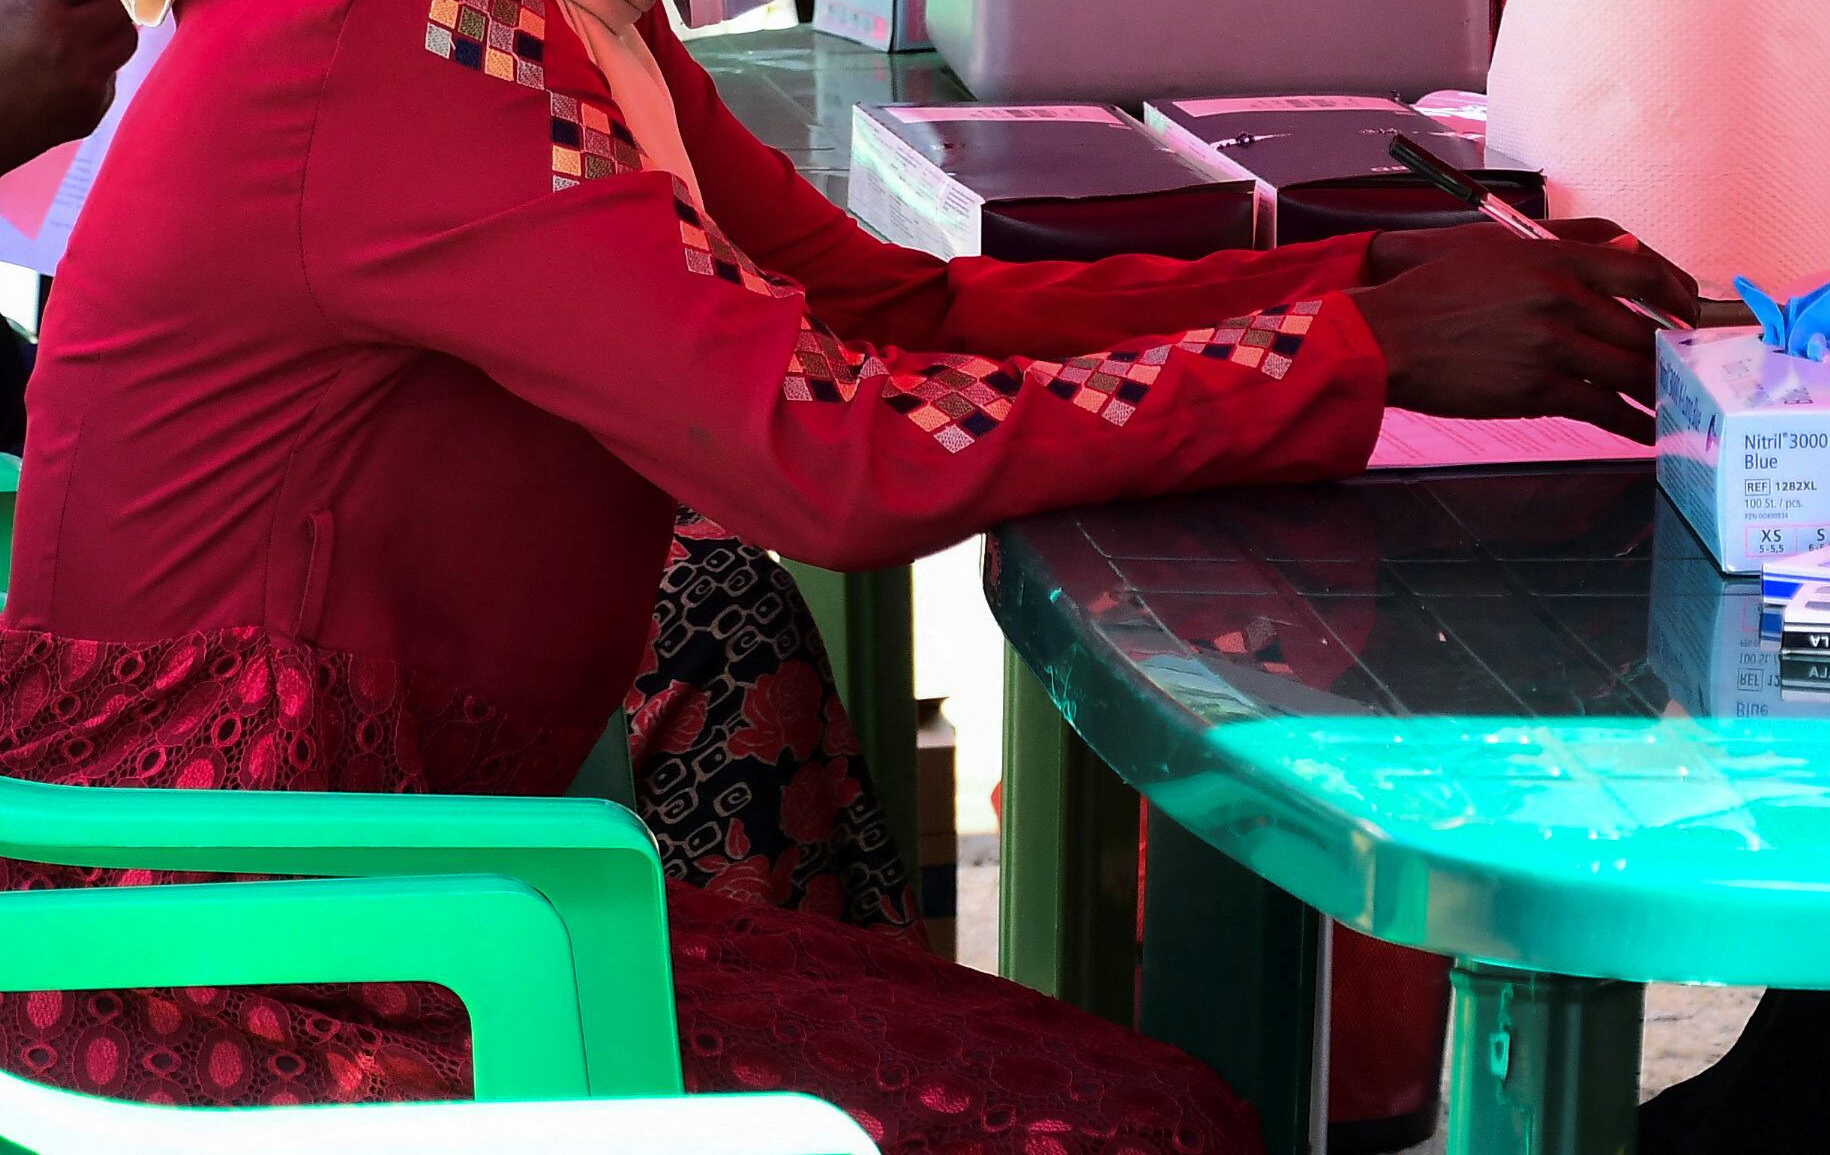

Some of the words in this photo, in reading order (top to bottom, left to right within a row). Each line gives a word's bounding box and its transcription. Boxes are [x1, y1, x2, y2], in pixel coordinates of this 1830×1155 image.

[1789, 433, 1828, 449] 3000
[1744, 453, 1778, 470] Blue
[1746, 482, 1769, 493] REF
[1775, 481, 1817, 492] 1282XL
[1744, 498, 1762, 509] 100
[1761, 528, 1782, 543] XS
[1816, 528, 1826, 542] S
